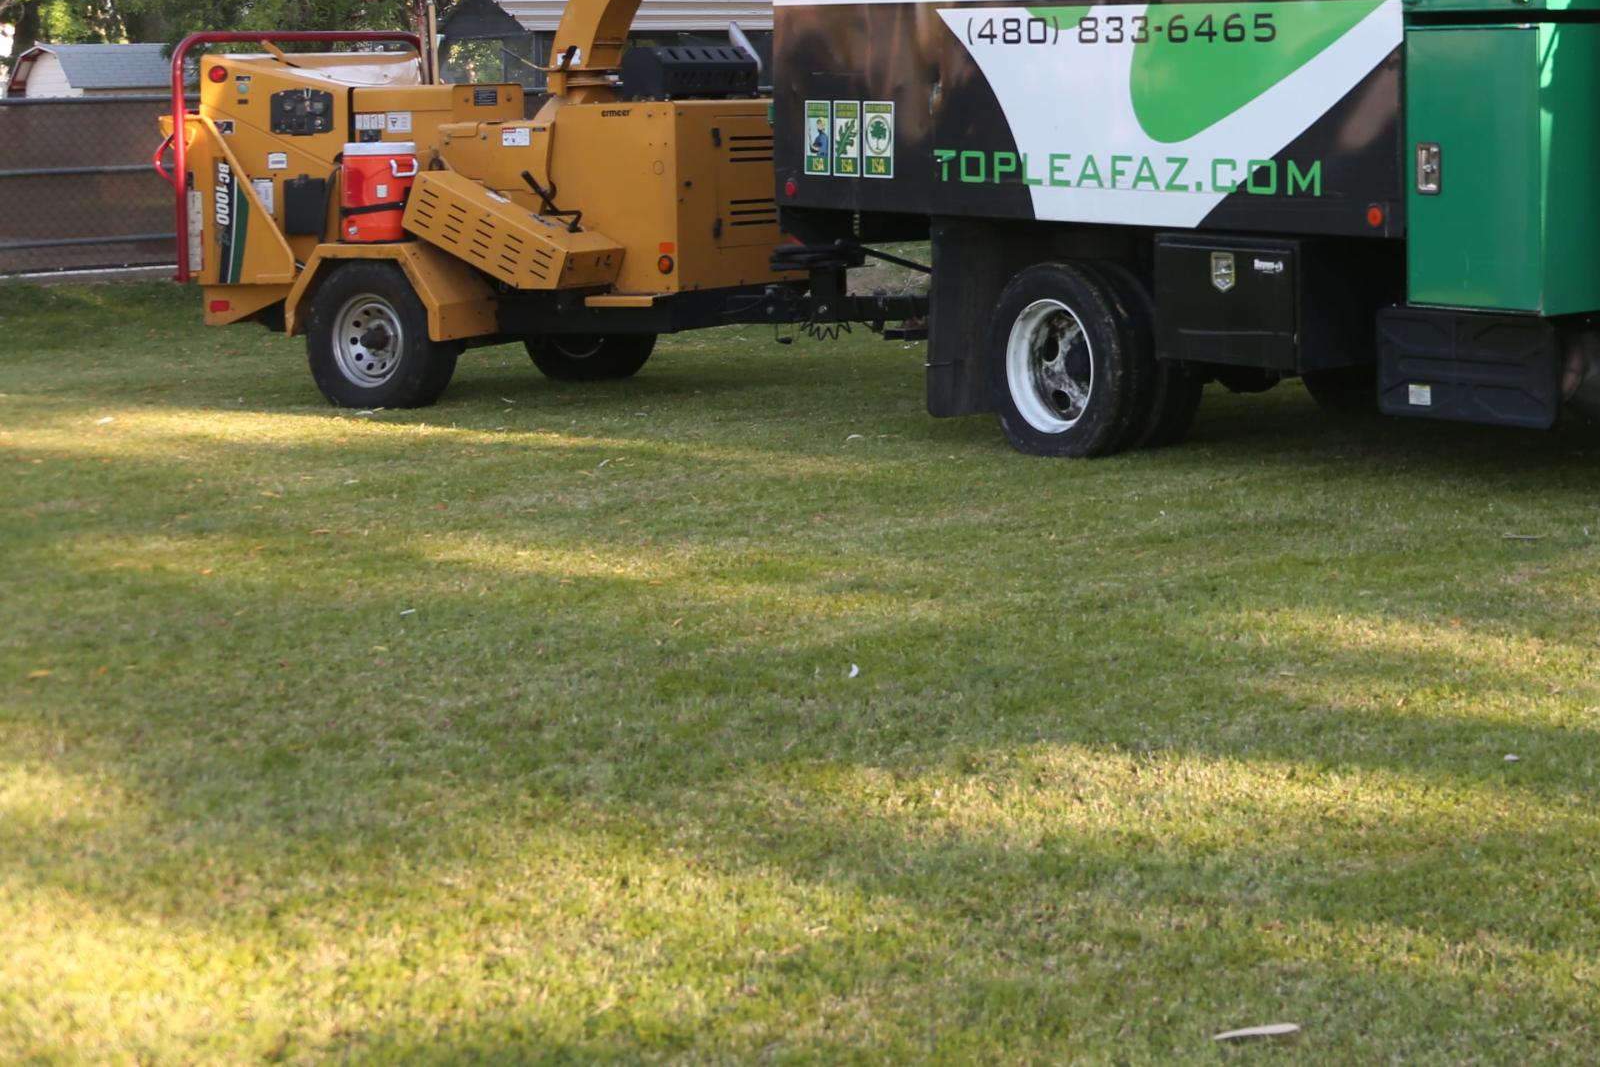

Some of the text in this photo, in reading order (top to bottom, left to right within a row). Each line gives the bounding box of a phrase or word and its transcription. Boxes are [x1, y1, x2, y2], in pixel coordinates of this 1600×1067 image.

[967, 13, 1277, 46] (480) 833-6465
[933, 148, 1322, 197] TOPLEAFAZ.COM
